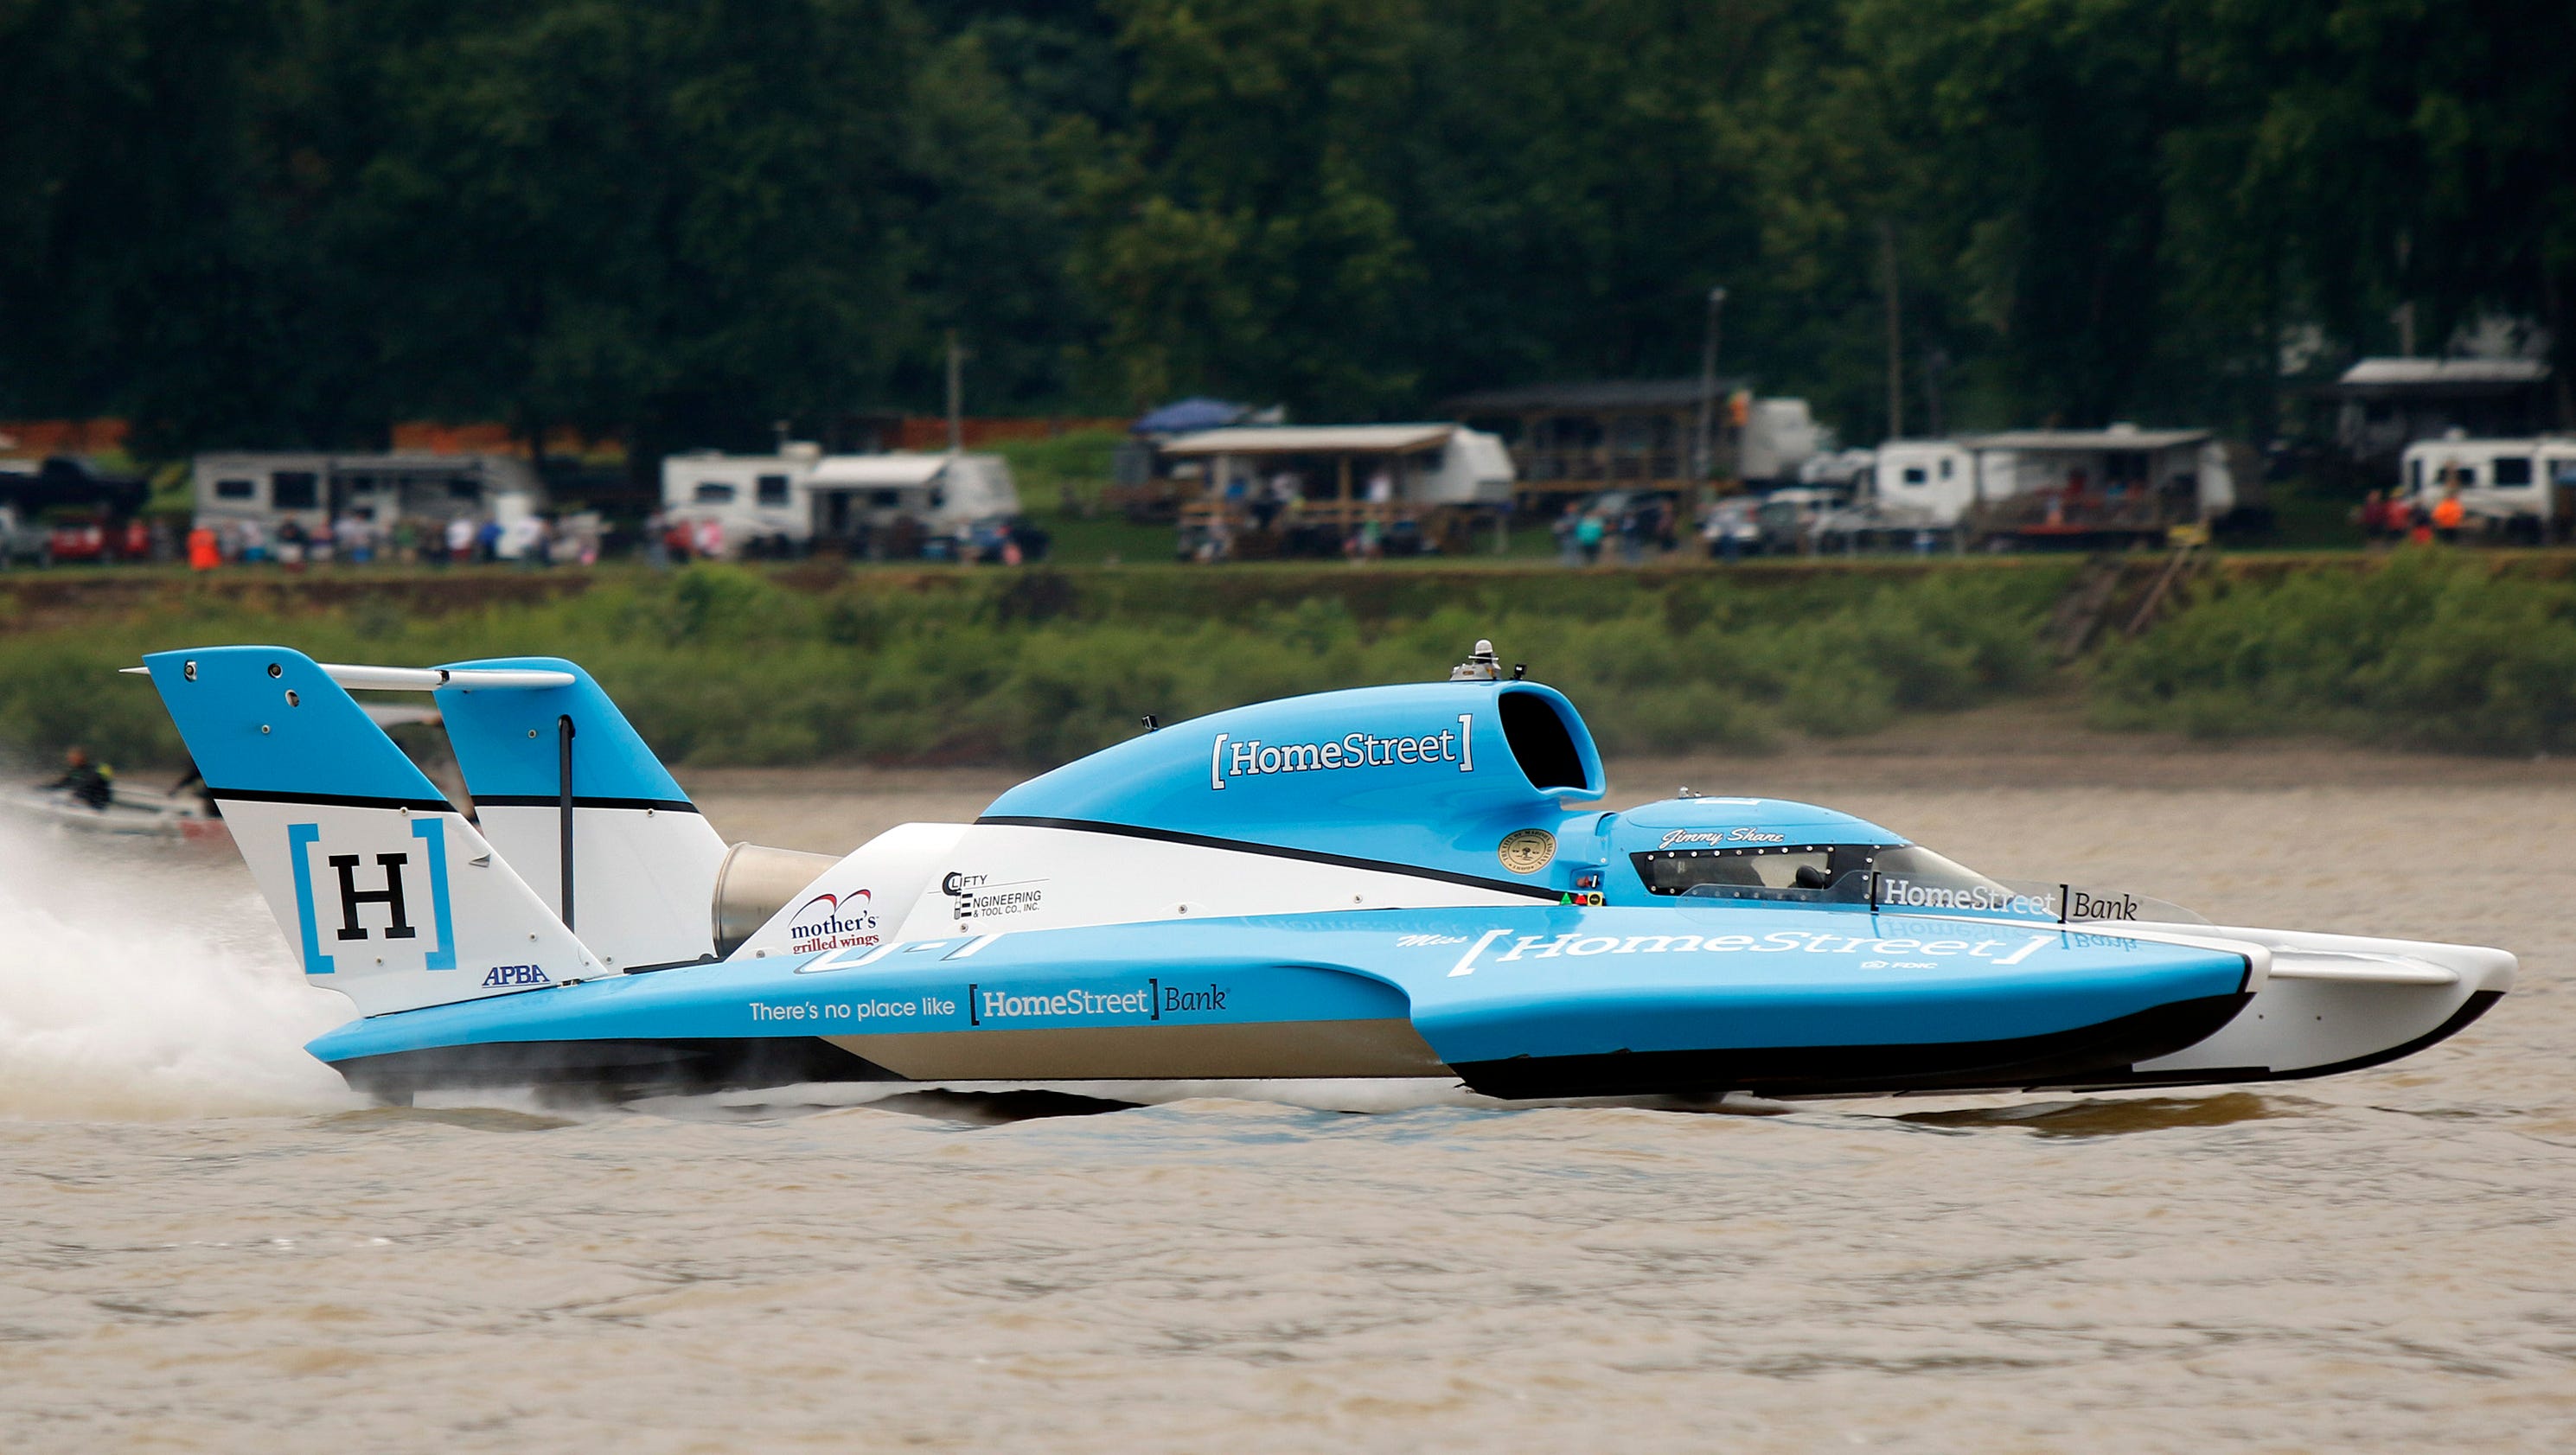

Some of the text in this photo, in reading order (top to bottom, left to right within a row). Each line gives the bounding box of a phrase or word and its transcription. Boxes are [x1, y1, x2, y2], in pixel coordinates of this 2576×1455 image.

[1658, 827, 1785, 850] Jimmy Shane
[942, 871, 988, 896] CLIFTY
[961, 890, 1042, 917] ENGINEERING
[981, 908, 1003, 917] TOOL
[1023, 902, 1039, 912] INC.
[2074, 892, 2138, 921] Bank
[790, 909, 877, 939] mother's
[793, 935, 879, 954] grilled wings
[1397, 934, 1468, 948] Miss
[482, 965, 551, 986] APBA
[750, 1001, 819, 1020] There's
[825, 1005, 851, 1018] no
[858, 998, 917, 1022] place
[922, 997, 956, 1016] like
